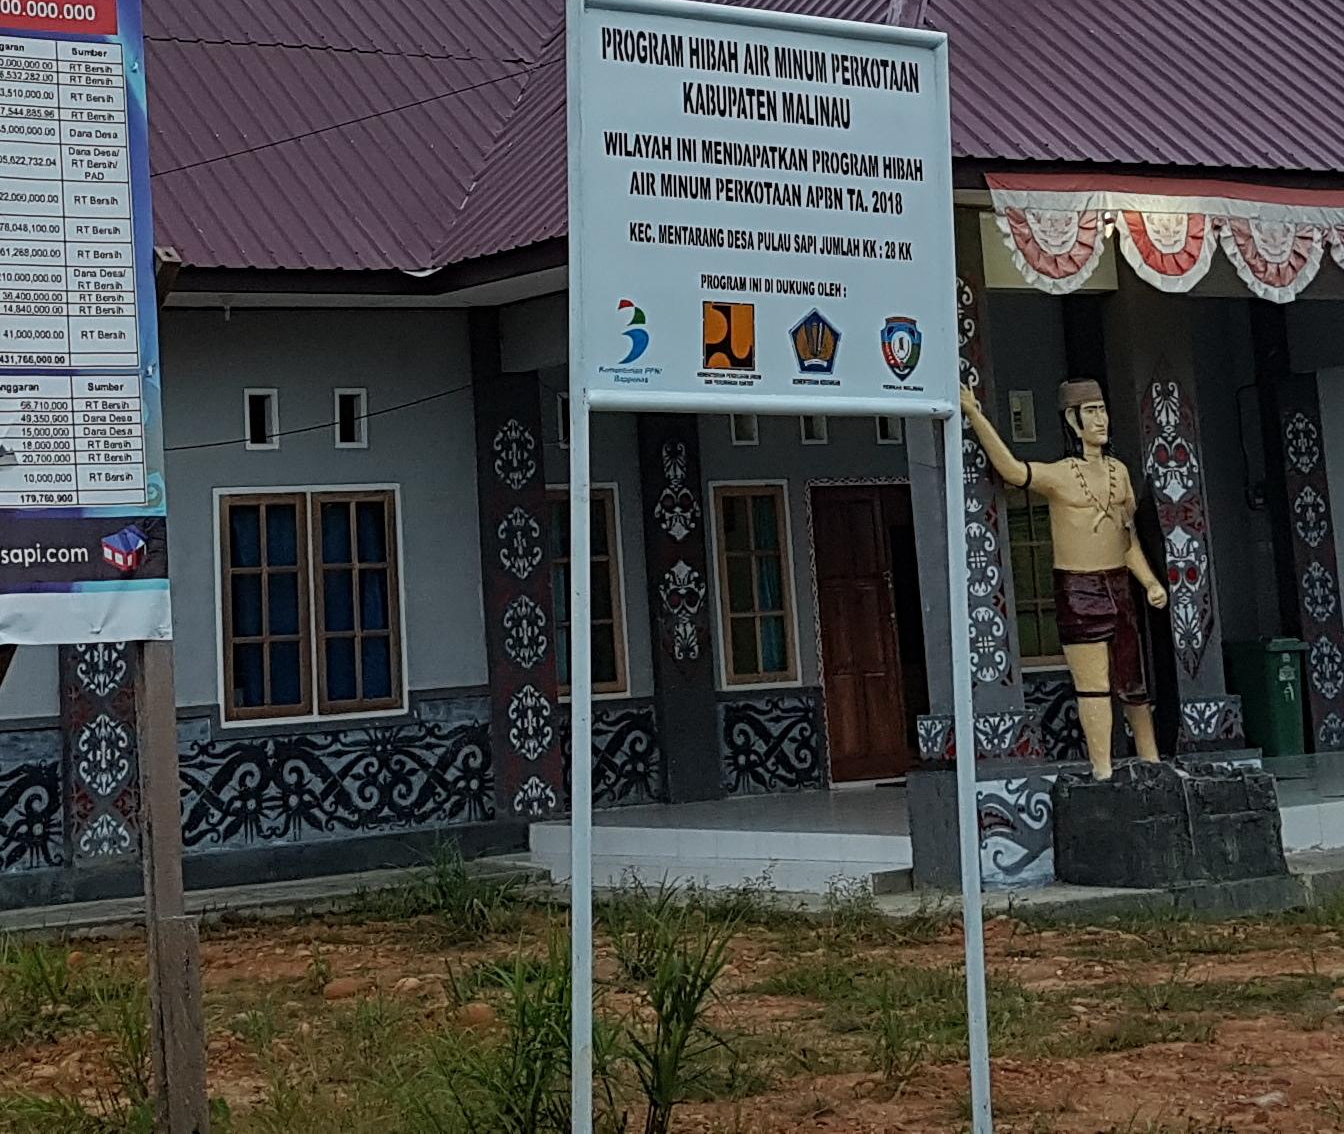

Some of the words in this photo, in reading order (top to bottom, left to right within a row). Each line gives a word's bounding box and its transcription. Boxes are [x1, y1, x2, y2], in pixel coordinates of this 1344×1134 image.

[601, 27, 684, 68] PROGRAM
[688, 36, 738, 74] HIBAH
[743, 43, 770, 79] AIR
[774, 46, 827, 85] MINUM
[831, 53, 920, 94] PERKOTAAN
[682, 82, 777, 122] KABUPATEN
[782, 92, 851, 129] MALINAU
[604, 131, 672, 161] WILAYAH
[676, 137, 698, 163] INI
[701, 139, 808, 172] MENDAPATKAN
[812, 149, 879, 179] PROGRAM
[882, 155, 924, 182] HIBAH
[629, 171, 656, 197] AIR
[660, 173, 712, 201] MINUM
[715, 178, 802, 207] PERKOTAAN
[805, 184, 843, 211] APBN
[846, 187, 868, 213] TA.
[872, 189, 903, 216] 2018
[629, 222, 655, 244] KEC.
[658, 224, 724, 249] MENTARANG
[727, 230, 755, 250] DESA
[757, 232, 791, 253] PULAU
[794, 234, 817, 255] SAPI
[820, 236, 860, 258] JUMLAH
[862, 240, 876, 259] KK
[885, 241, 896, 260] 28
[898, 242, 912, 262] KK
[700, 274, 747, 292] PROGRAM
[748, 277, 762, 293] INI
[764, 279, 774, 293] DI
[775, 279, 815, 297] DUKUNG
[817, 281, 841, 298] OLEH
[87, 382, 124, 392] Sumber
